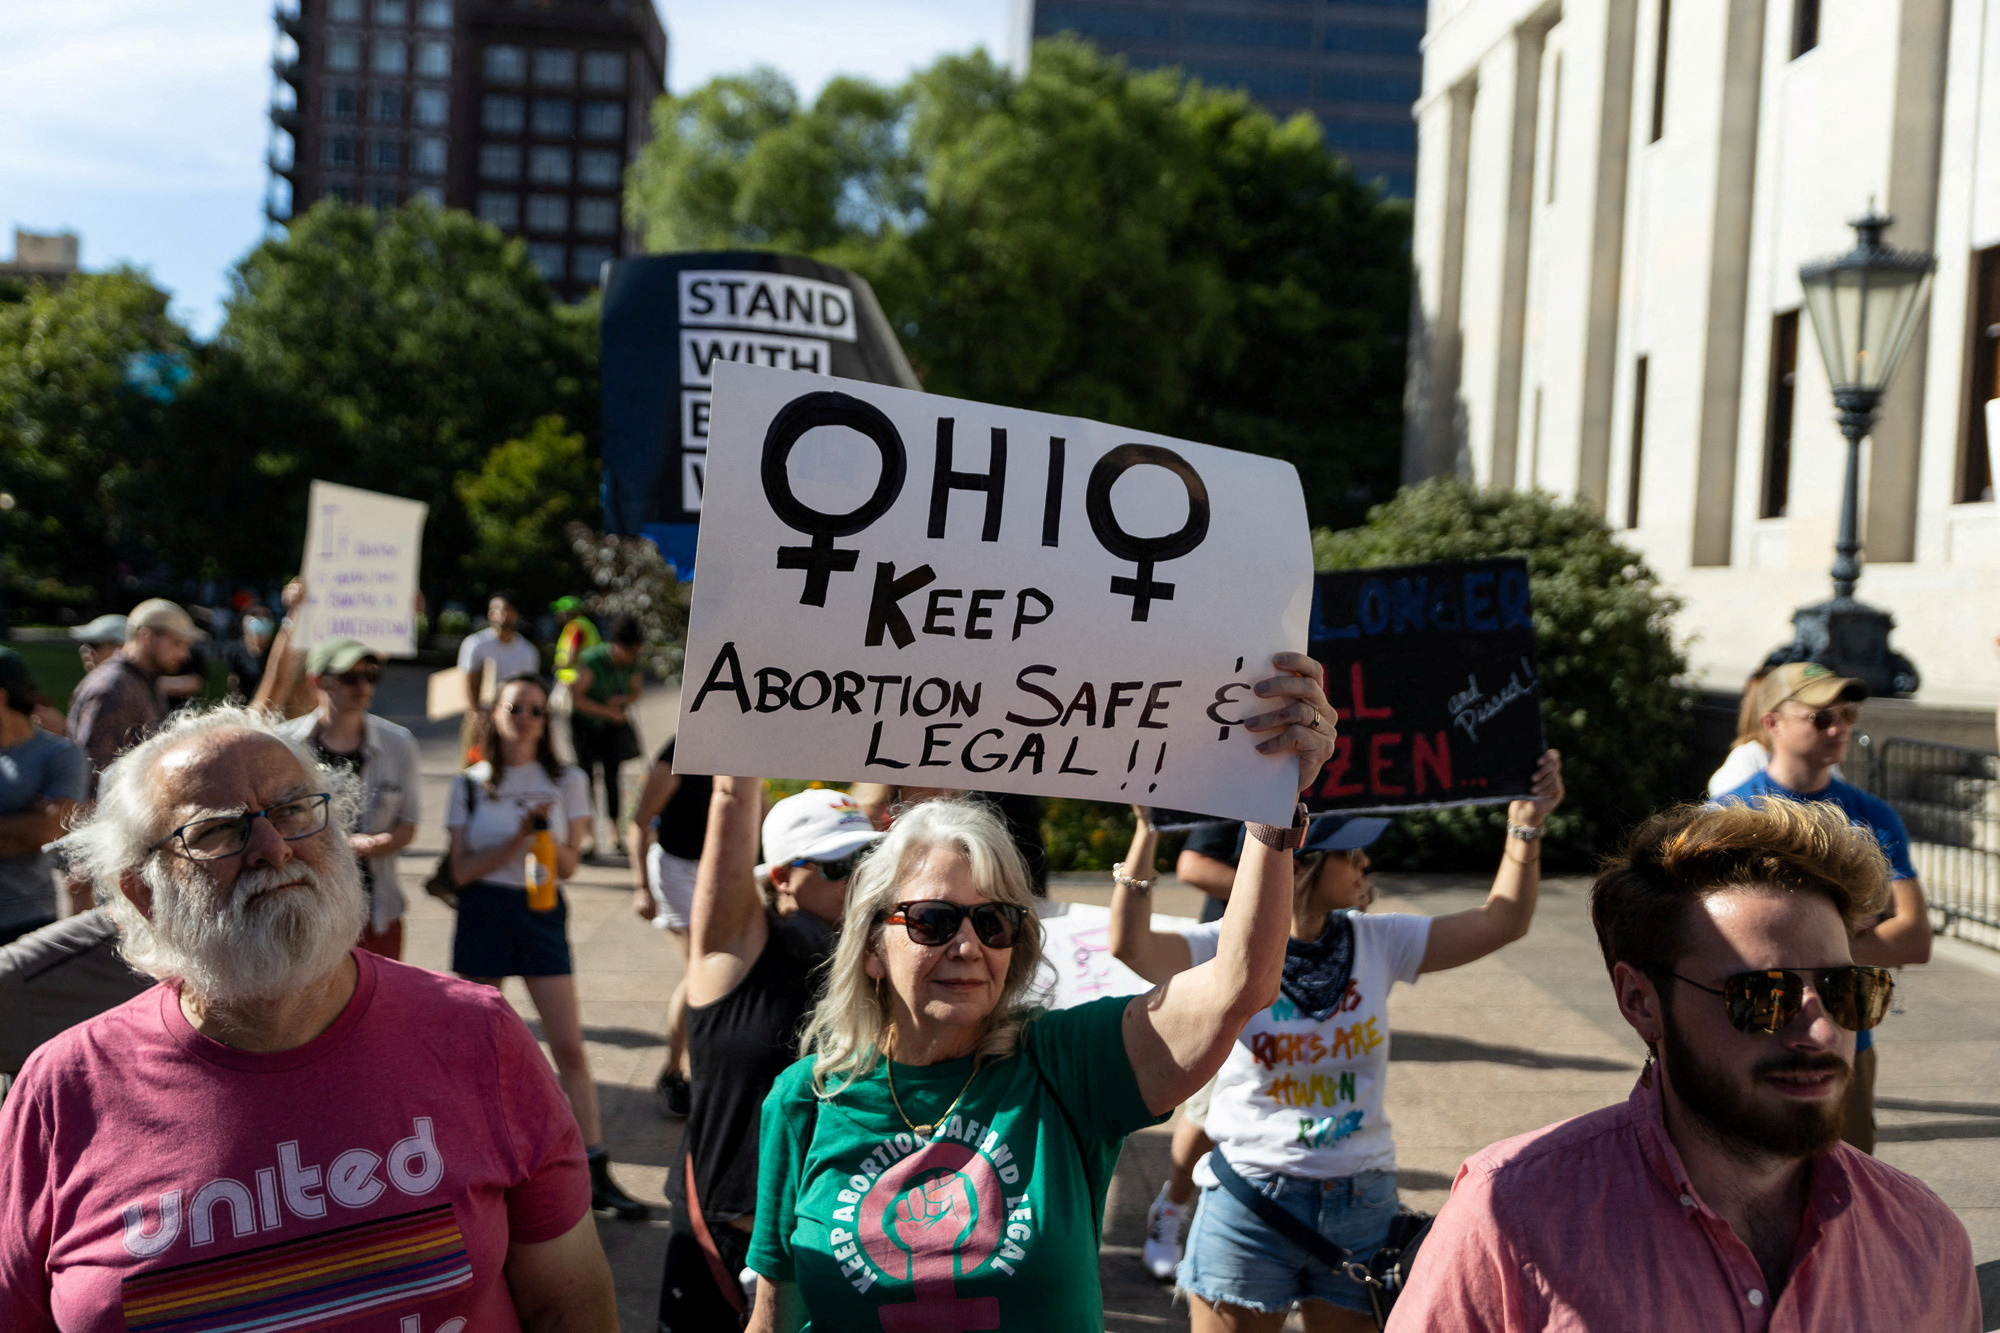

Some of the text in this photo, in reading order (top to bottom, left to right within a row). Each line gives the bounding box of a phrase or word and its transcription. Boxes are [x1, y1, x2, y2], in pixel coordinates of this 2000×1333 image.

[689, 280, 847, 328] STAND
[690, 339, 819, 376] WITH
[761, 390, 1210, 622] OHIO
[864, 561, 1054, 649] KEEP
[690, 641, 982, 715] ABORTION
[1006, 664, 1183, 728] SAFE
[121, 1116, 445, 1259] united
[832, 1131, 930, 1223] ABORTION
[980, 1130, 1020, 1185] AND
[830, 1227, 878, 1294] KEEP
[990, 1193, 1032, 1277] LEGAL
